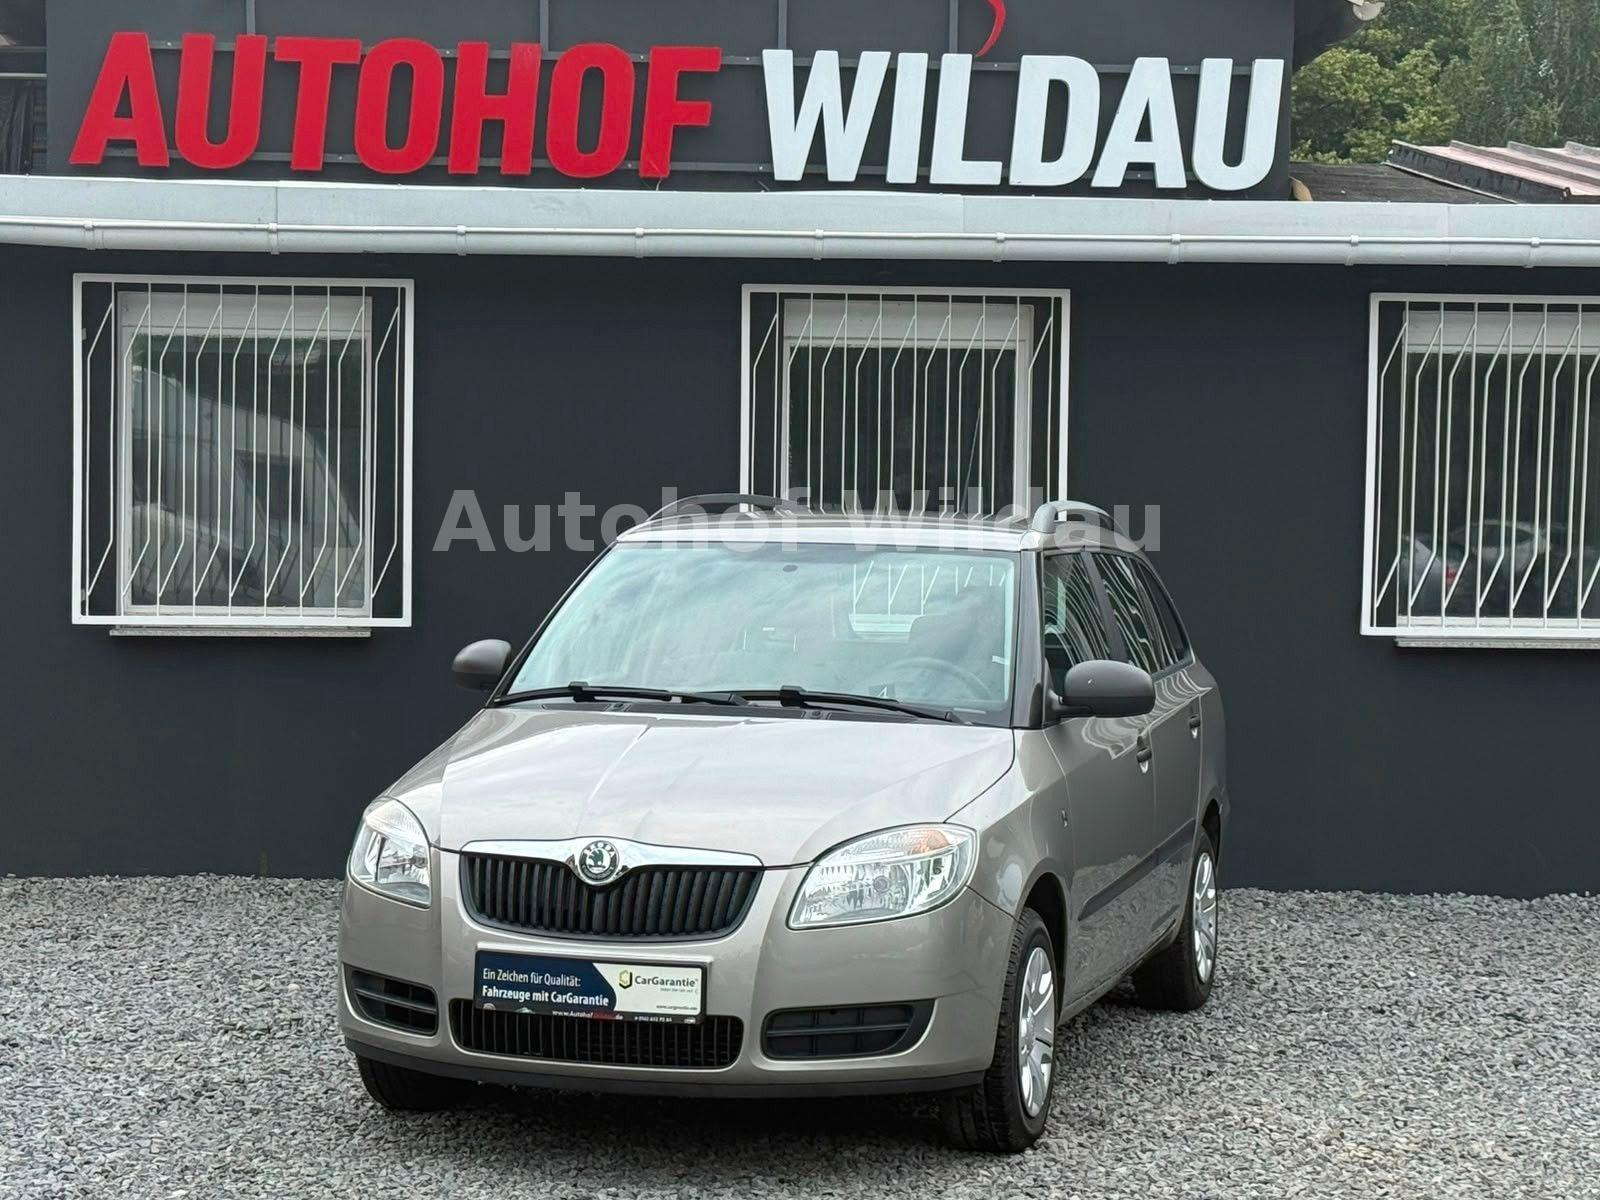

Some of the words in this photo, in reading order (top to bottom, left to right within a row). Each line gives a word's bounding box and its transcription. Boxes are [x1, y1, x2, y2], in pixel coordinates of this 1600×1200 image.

[69, 32, 722, 179] AUTOHOF
[761, 48, 1285, 192] WILDAU
[483, 967, 496, 980] Ein
[497, 969, 529, 983] Zeichen
[530, 971, 543, 985] für
[544, 973, 582, 987] Qualität:
[634, 975, 696, 988] CarGarantie
[482, 985, 531, 1003] Fahrzeuge
[532, 990, 550, 1003] mit
[551, 991, 610, 1007] CarGarantie
